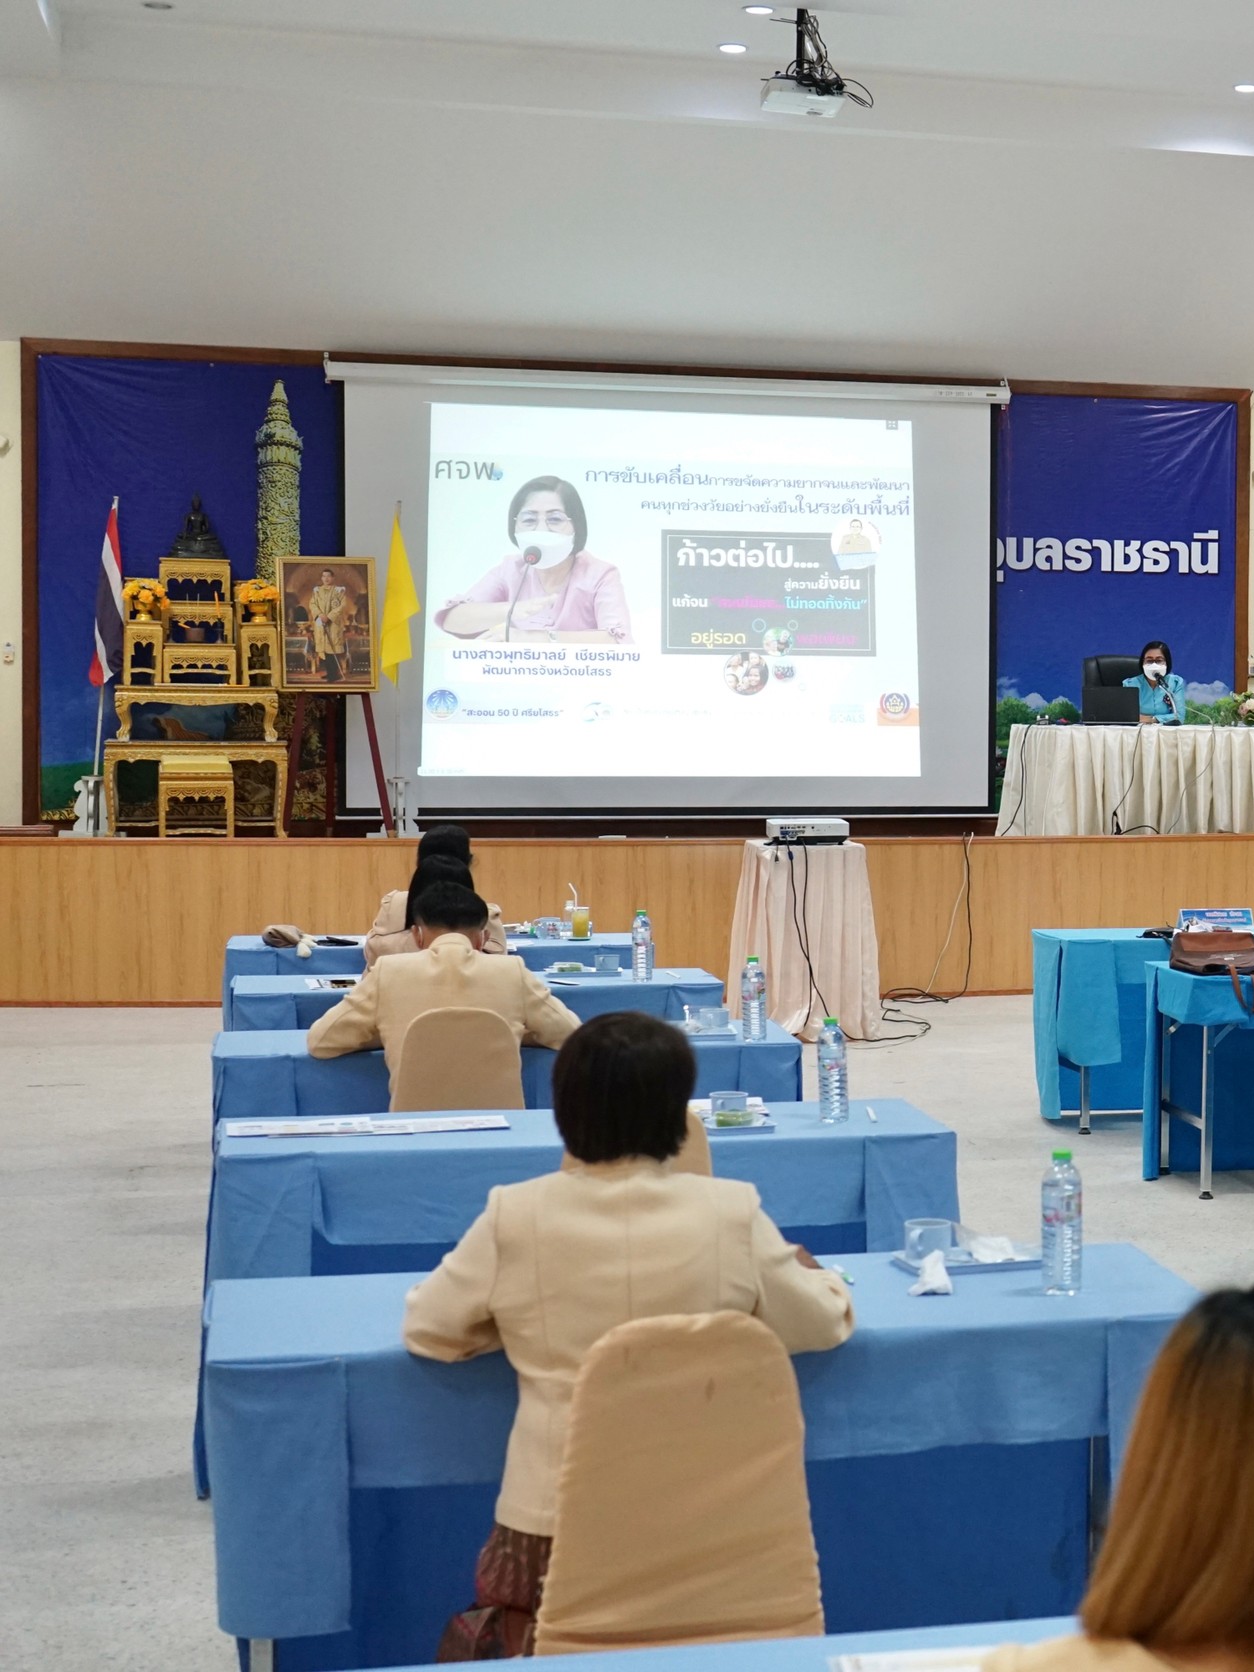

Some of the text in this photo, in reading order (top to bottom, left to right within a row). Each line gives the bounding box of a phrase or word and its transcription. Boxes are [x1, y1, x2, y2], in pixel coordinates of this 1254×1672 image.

[672, 593, 708, 608] แก้จน
[691, 628, 746, 648] อยู่รอด
[482, 664, 613, 678] พัฒนาการจังหวัดยโสธร
[497, 709, 510, 717] 50
